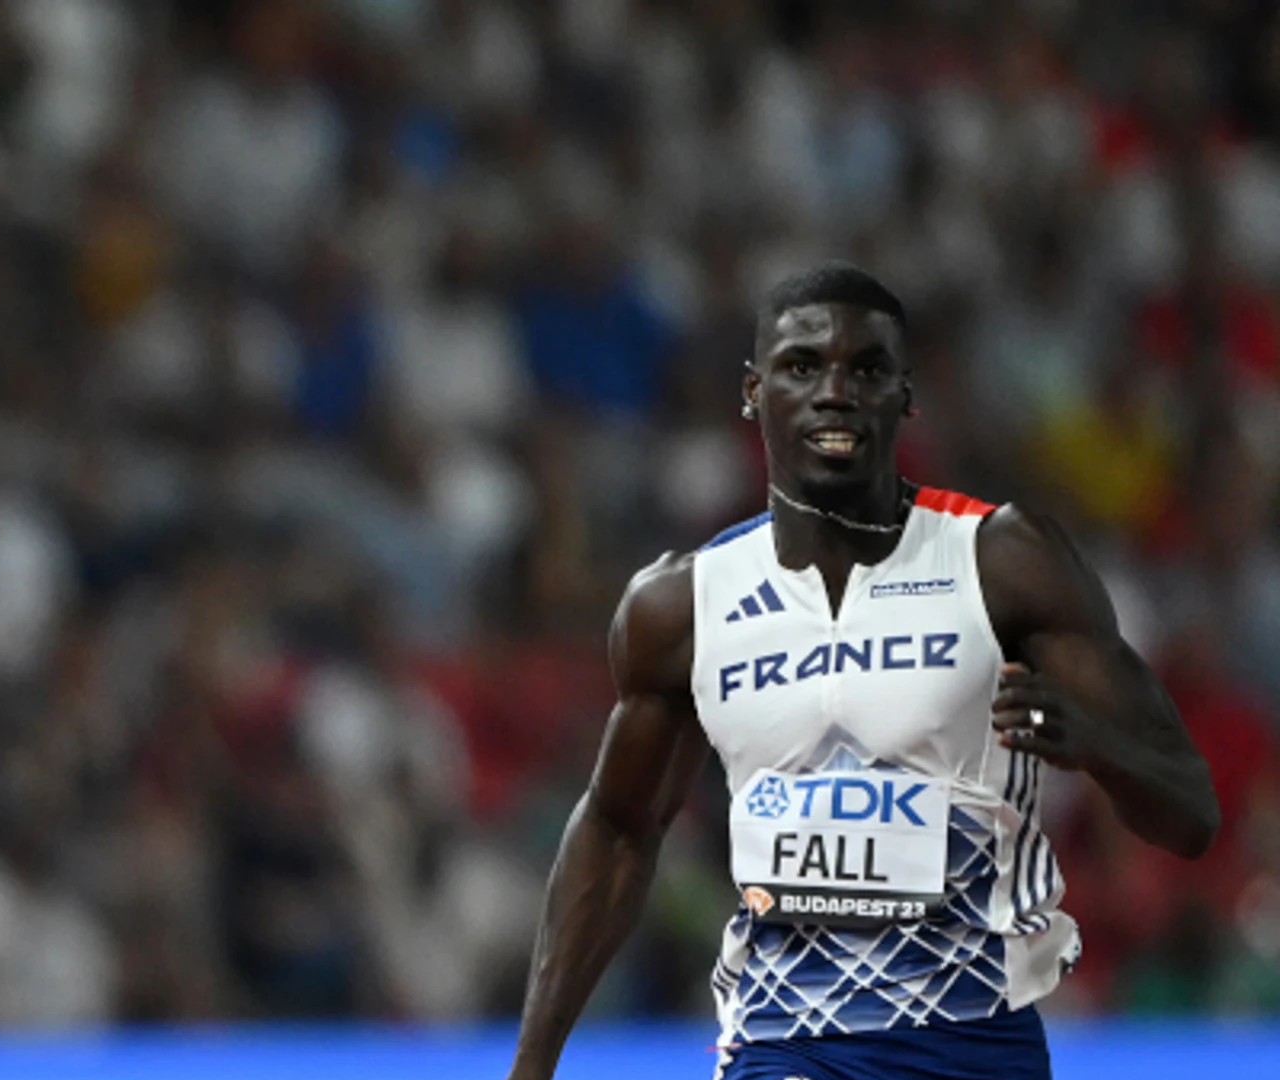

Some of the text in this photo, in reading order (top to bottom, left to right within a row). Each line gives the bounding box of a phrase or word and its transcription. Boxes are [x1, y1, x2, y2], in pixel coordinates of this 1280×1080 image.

[719, 633, 960, 702] FRANCE
[793, 780, 929, 826] TDK
[771, 832, 889, 883] FALL
[780, 895, 926, 918] BUDAPEST 23
